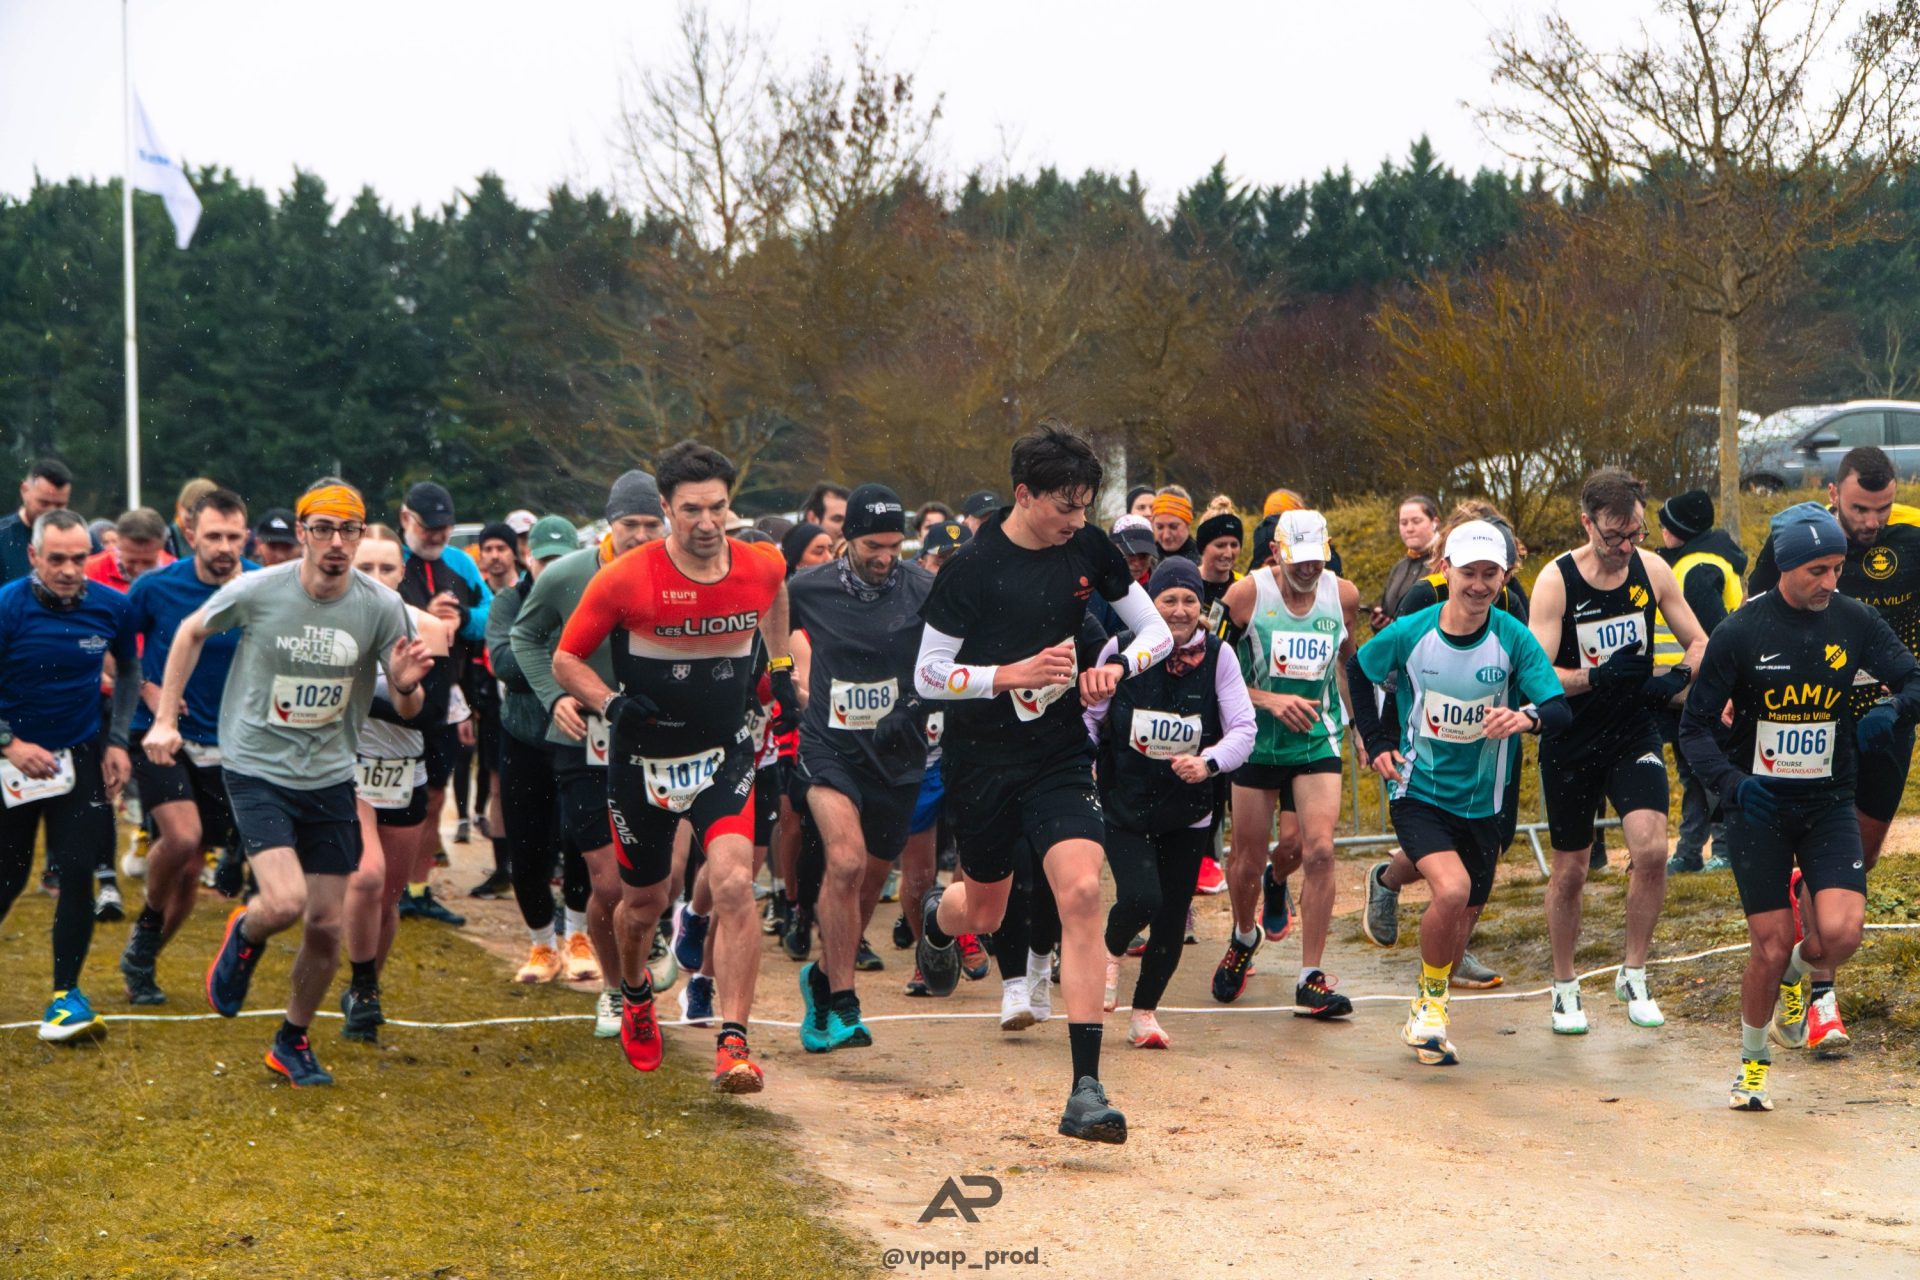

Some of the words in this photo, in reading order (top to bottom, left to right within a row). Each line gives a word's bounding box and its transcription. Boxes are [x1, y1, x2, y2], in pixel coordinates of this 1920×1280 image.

[303, 625, 335, 641] THE
[656, 627, 682, 636] LES
[684, 611, 759, 636] LIONS
[1597, 620, 1638, 649] 1073
[276, 636, 333, 654] NORTH
[1288, 637, 1327, 661] 1064
[291, 650, 332, 665] FACE
[296, 685, 343, 707] 1028
[846, 686, 890, 710] 1068
[1764, 683, 1841, 710] CAMV
[1443, 703, 1484, 726] 1048
[1768, 711, 1801, 721] Mantes
[1803, 711, 1812, 720] la
[1813, 711, 1831, 720] Ville
[1151, 719, 1194, 742] 1020
[1776, 728, 1827, 755] 1066
[363, 766, 404, 787] 1672
[666, 757, 714, 788] 1074
[1776, 767, 1823, 775] ORGANISATION
[607, 799, 639, 844] LIONS
